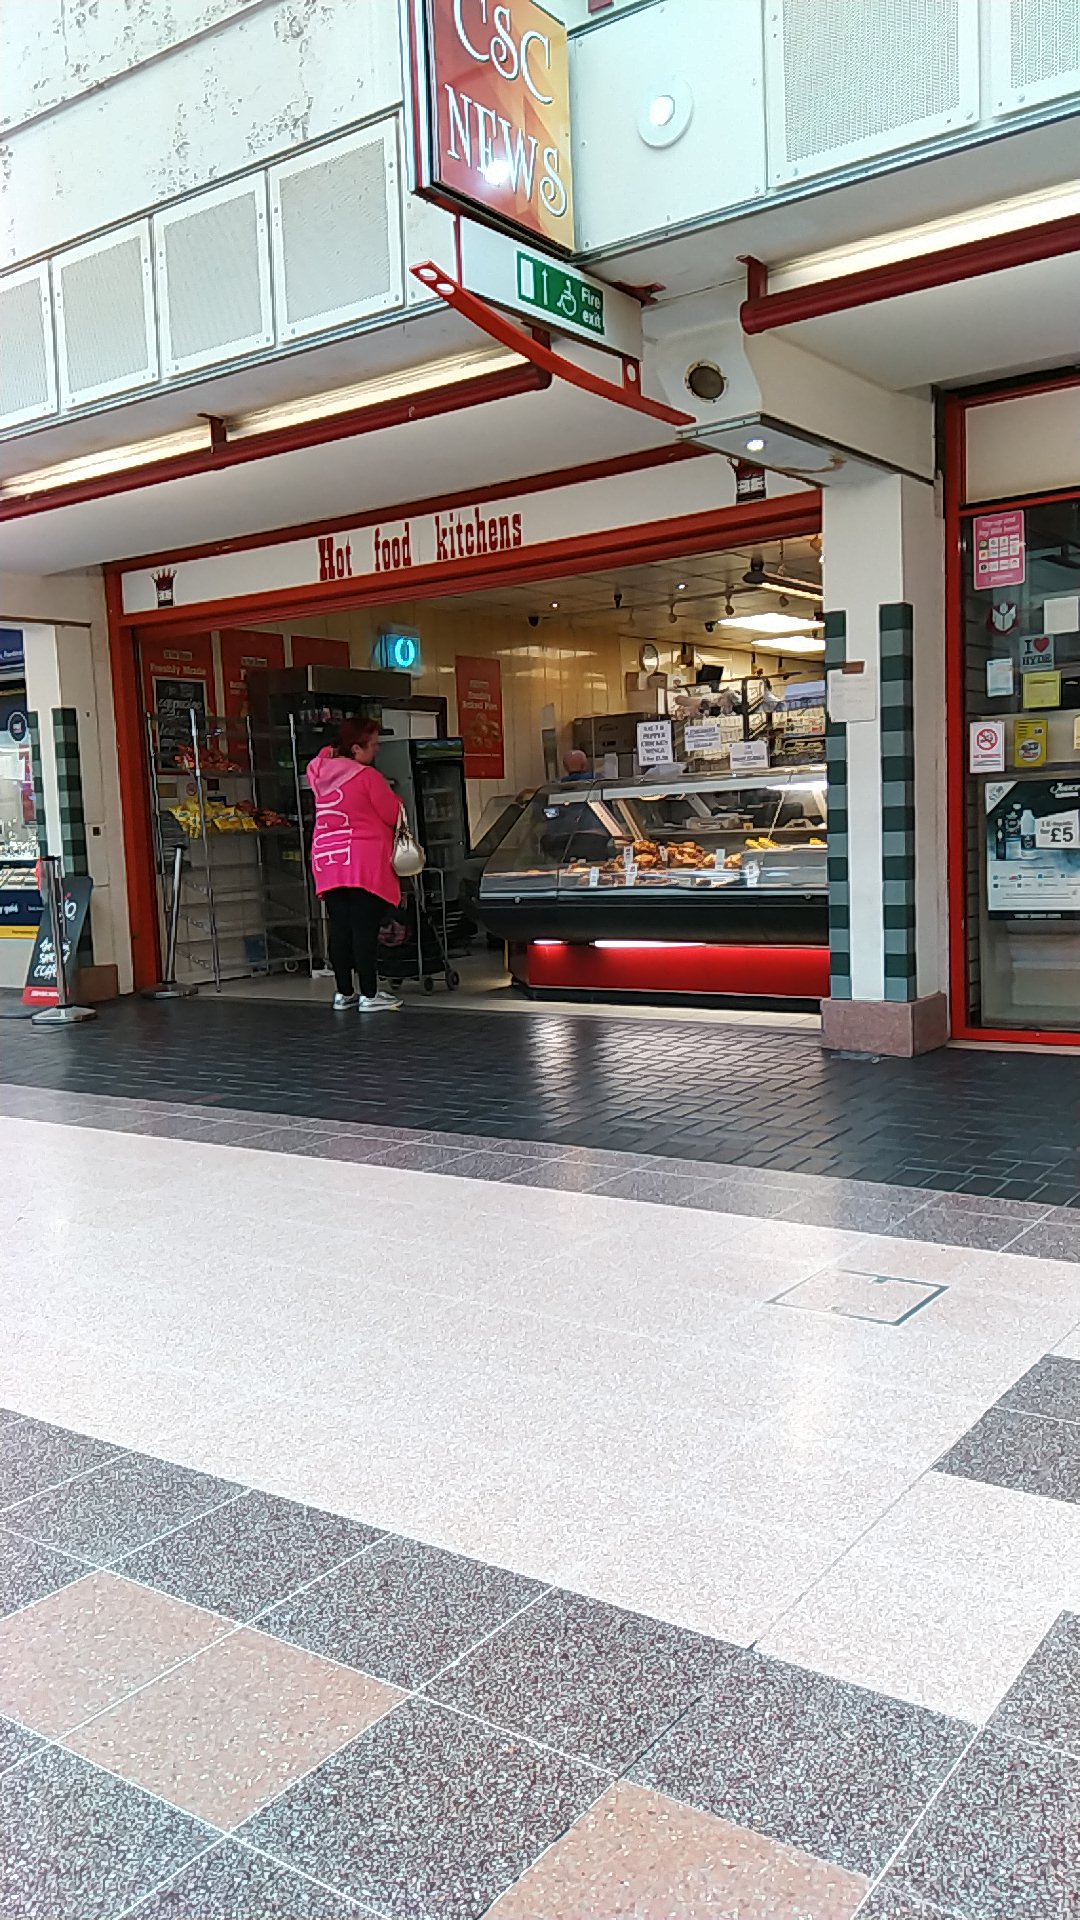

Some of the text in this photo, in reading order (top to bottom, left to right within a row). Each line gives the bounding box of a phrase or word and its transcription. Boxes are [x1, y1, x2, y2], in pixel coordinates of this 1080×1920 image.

[453, 0, 553, 105] CSC
[444, 82, 568, 218] NEWS
[580, 286, 601, 309] Fire
[581, 310, 603, 330] exit
[318, 506, 522, 581] Hot food kitchens
[1024, 639, 1033, 655] I
[1050, 827, 1074, 843] £5
